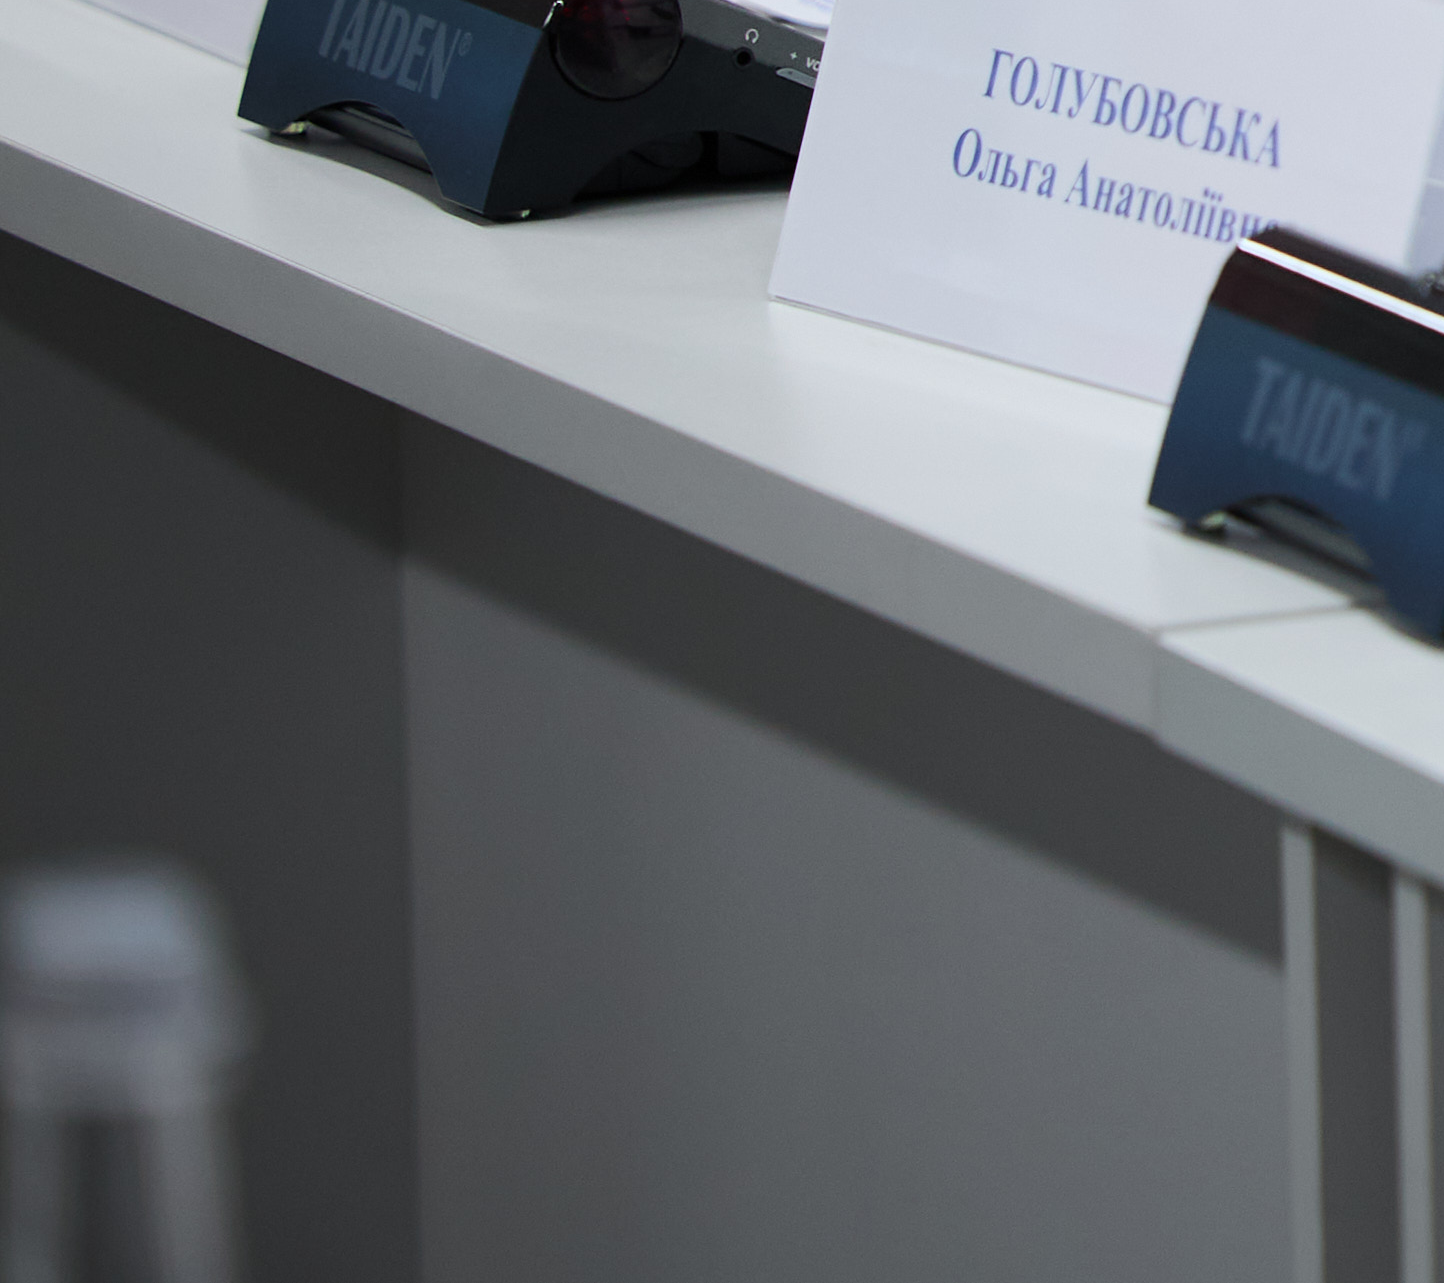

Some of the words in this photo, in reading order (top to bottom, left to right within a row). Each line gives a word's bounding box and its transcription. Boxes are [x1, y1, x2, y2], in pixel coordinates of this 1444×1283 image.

[982, 48, 1281, 169] ГОЛУБОВСЬКА
[953, 128, 1058, 199] Ольга
[1064, 158, 1280, 244] Анатоліївн
